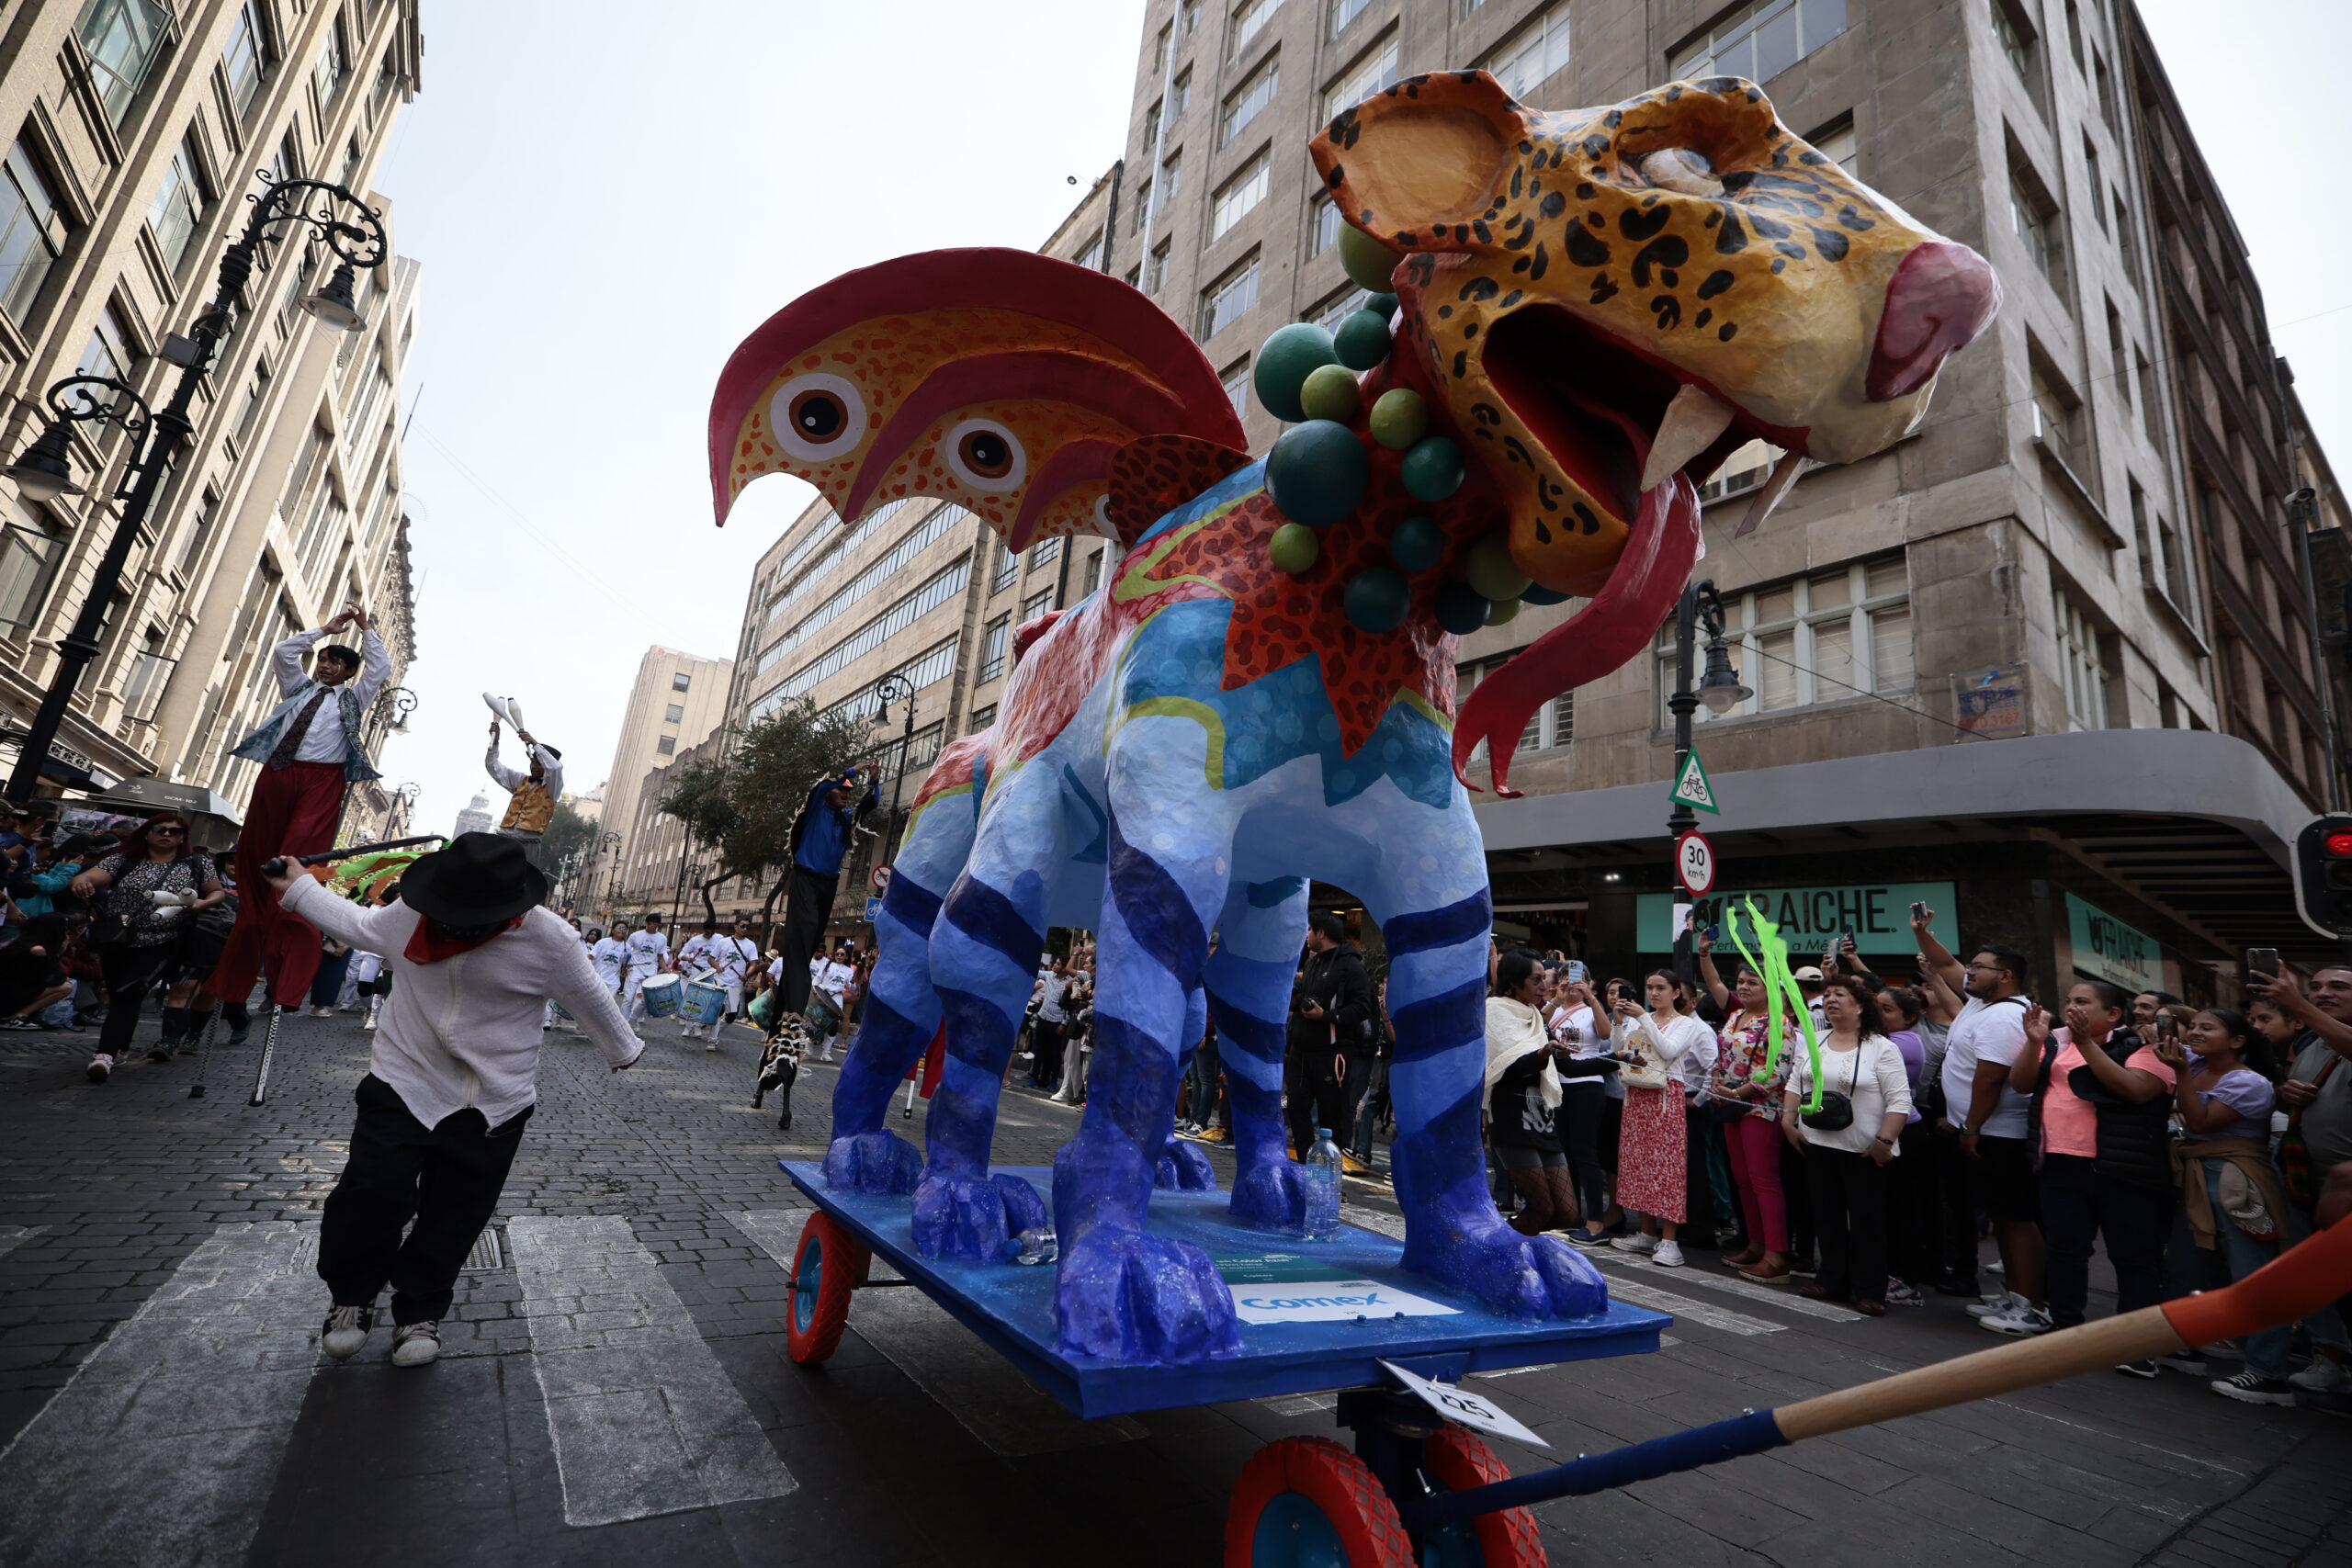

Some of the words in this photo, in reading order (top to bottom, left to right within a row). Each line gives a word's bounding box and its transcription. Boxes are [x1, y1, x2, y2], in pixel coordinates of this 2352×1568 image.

[1688, 845, 1705, 866] 30
[1687, 866, 1706, 881] km/h
[1792, 942, 1801, 952] a
[1426, 1386, 1496, 1420] 225
